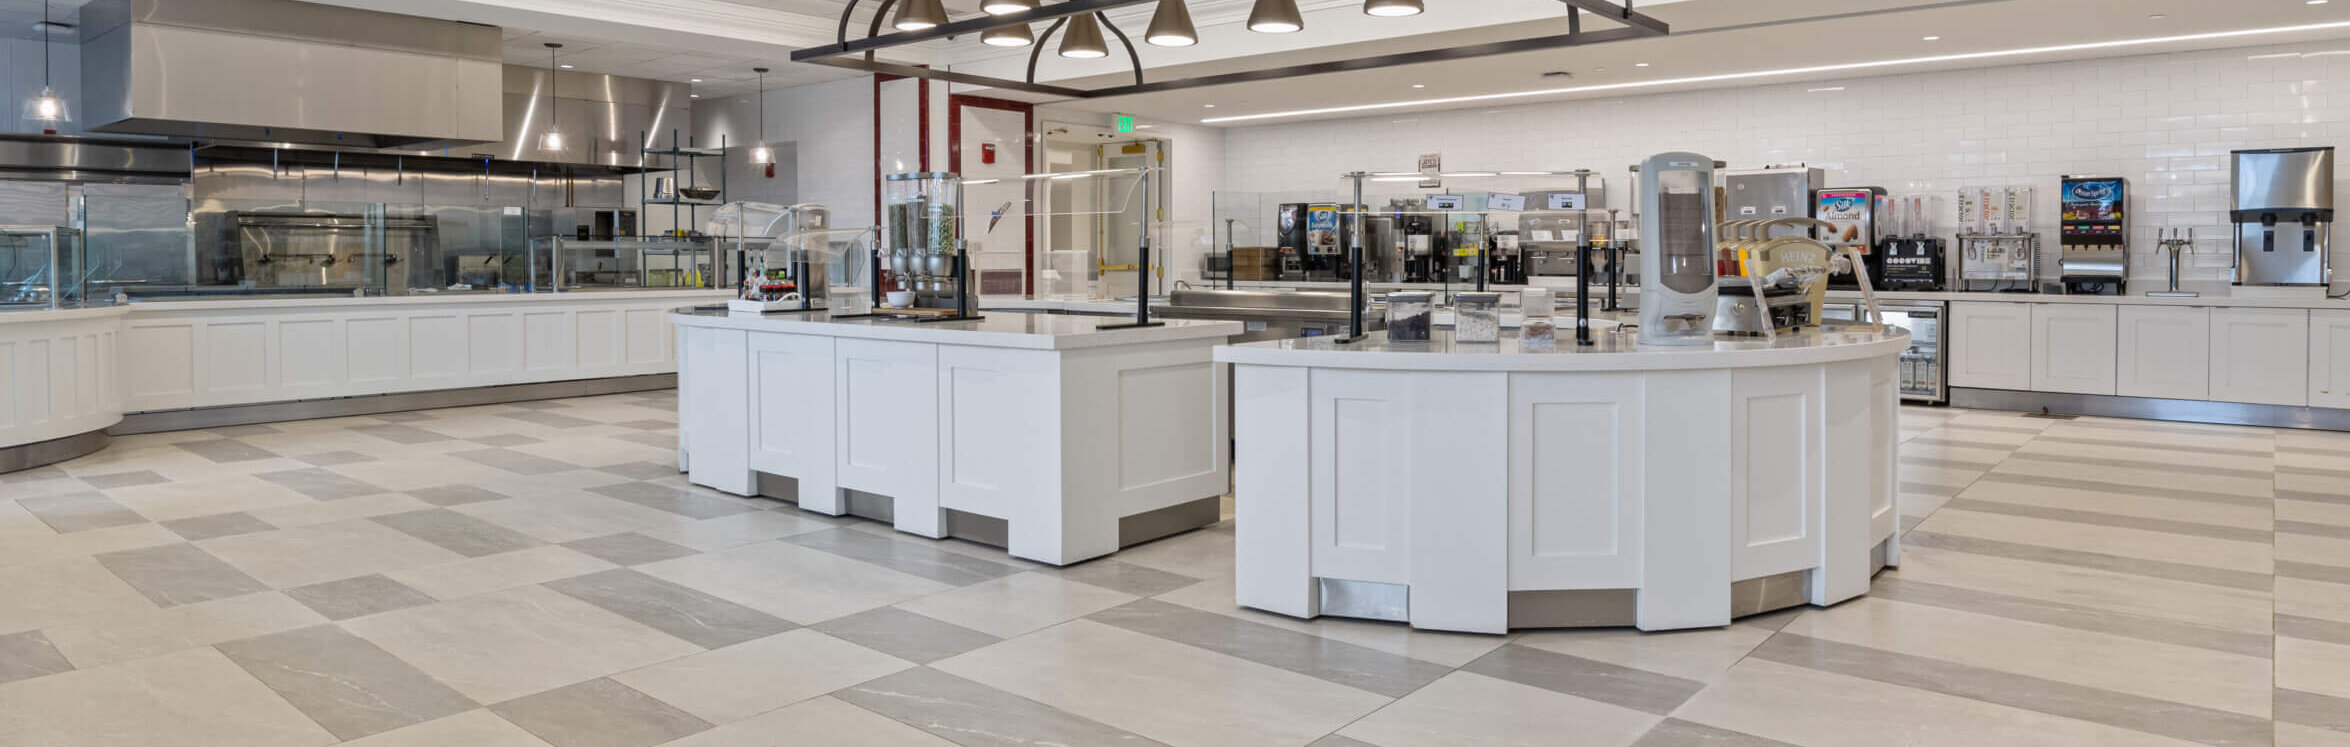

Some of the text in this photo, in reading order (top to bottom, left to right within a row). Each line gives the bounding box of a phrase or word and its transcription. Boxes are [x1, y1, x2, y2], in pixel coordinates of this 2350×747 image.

[1118, 116, 1133, 131] EXIT
[1826, 211, 1860, 220] Almond
[1781, 251, 1816, 264] HEINZ
